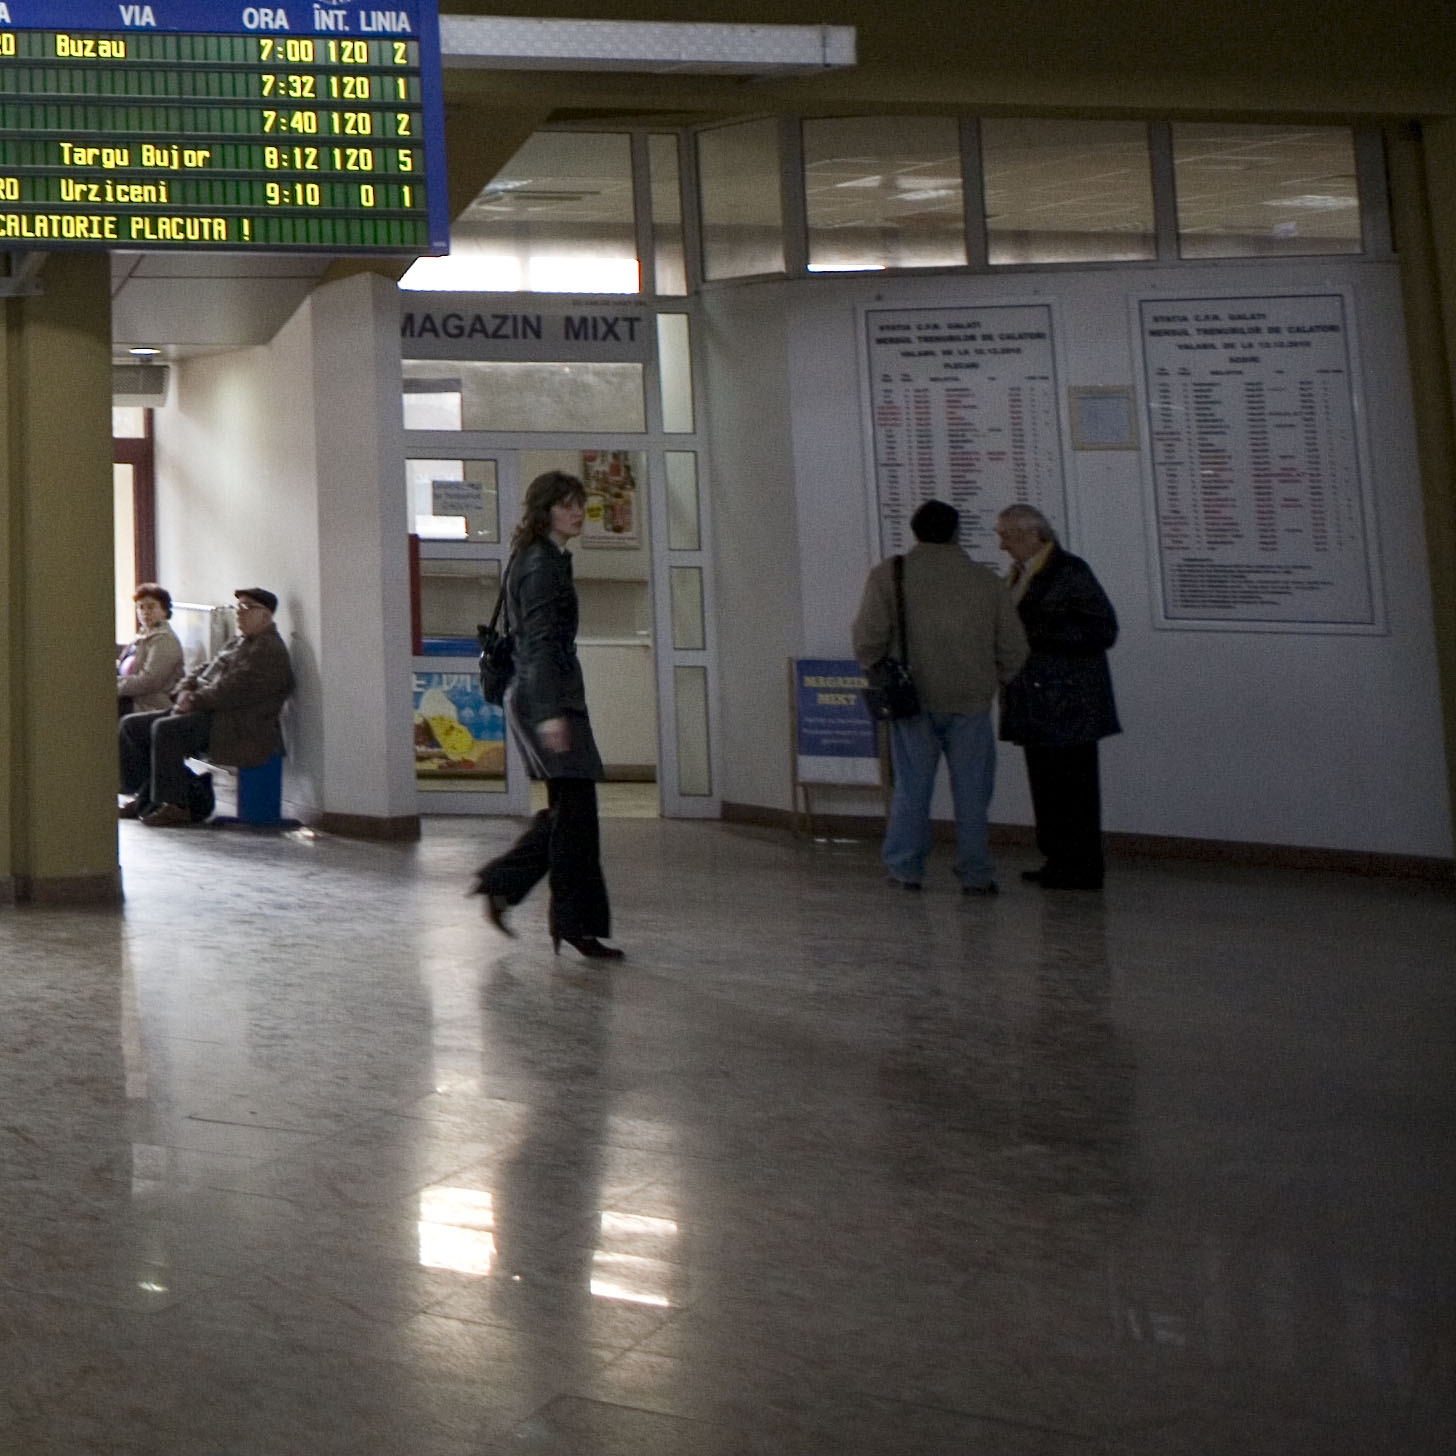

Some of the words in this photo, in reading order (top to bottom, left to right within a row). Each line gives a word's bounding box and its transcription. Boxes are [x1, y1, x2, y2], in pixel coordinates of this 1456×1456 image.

[118, 4, 157, 27] VIA
[242, 7, 290, 30] ORA
[359, 10, 412, 33] LINIA
[56, 34, 126, 58] Buzau
[259, 38, 314, 62] 7:00
[327, 40, 368, 64] 120
[393, 41, 408, 64] 2
[261, 74, 316, 98] 7:32
[330, 76, 370, 99] 120
[397, 77, 406, 100] 1
[263, 110, 317, 134] 7:40
[331, 111, 371, 135] 120
[396, 113, 411, 136] 2
[59, 142, 129, 169] Targu
[141, 144, 210, 170] Bujor
[264, 146, 319, 170] 8:12
[333, 147, 373, 171] 120
[398, 149, 412, 172] 5
[60, 178, 168, 203] Urziceni
[266, 182, 320, 206] 9:10
[360, 184, 374, 207] 0
[402, 185, 411, 208] 1
[130, 216, 227, 241] PLACUTA
[401, 313, 542, 340] MAGAZIN
[565, 315, 642, 342] MIXT
